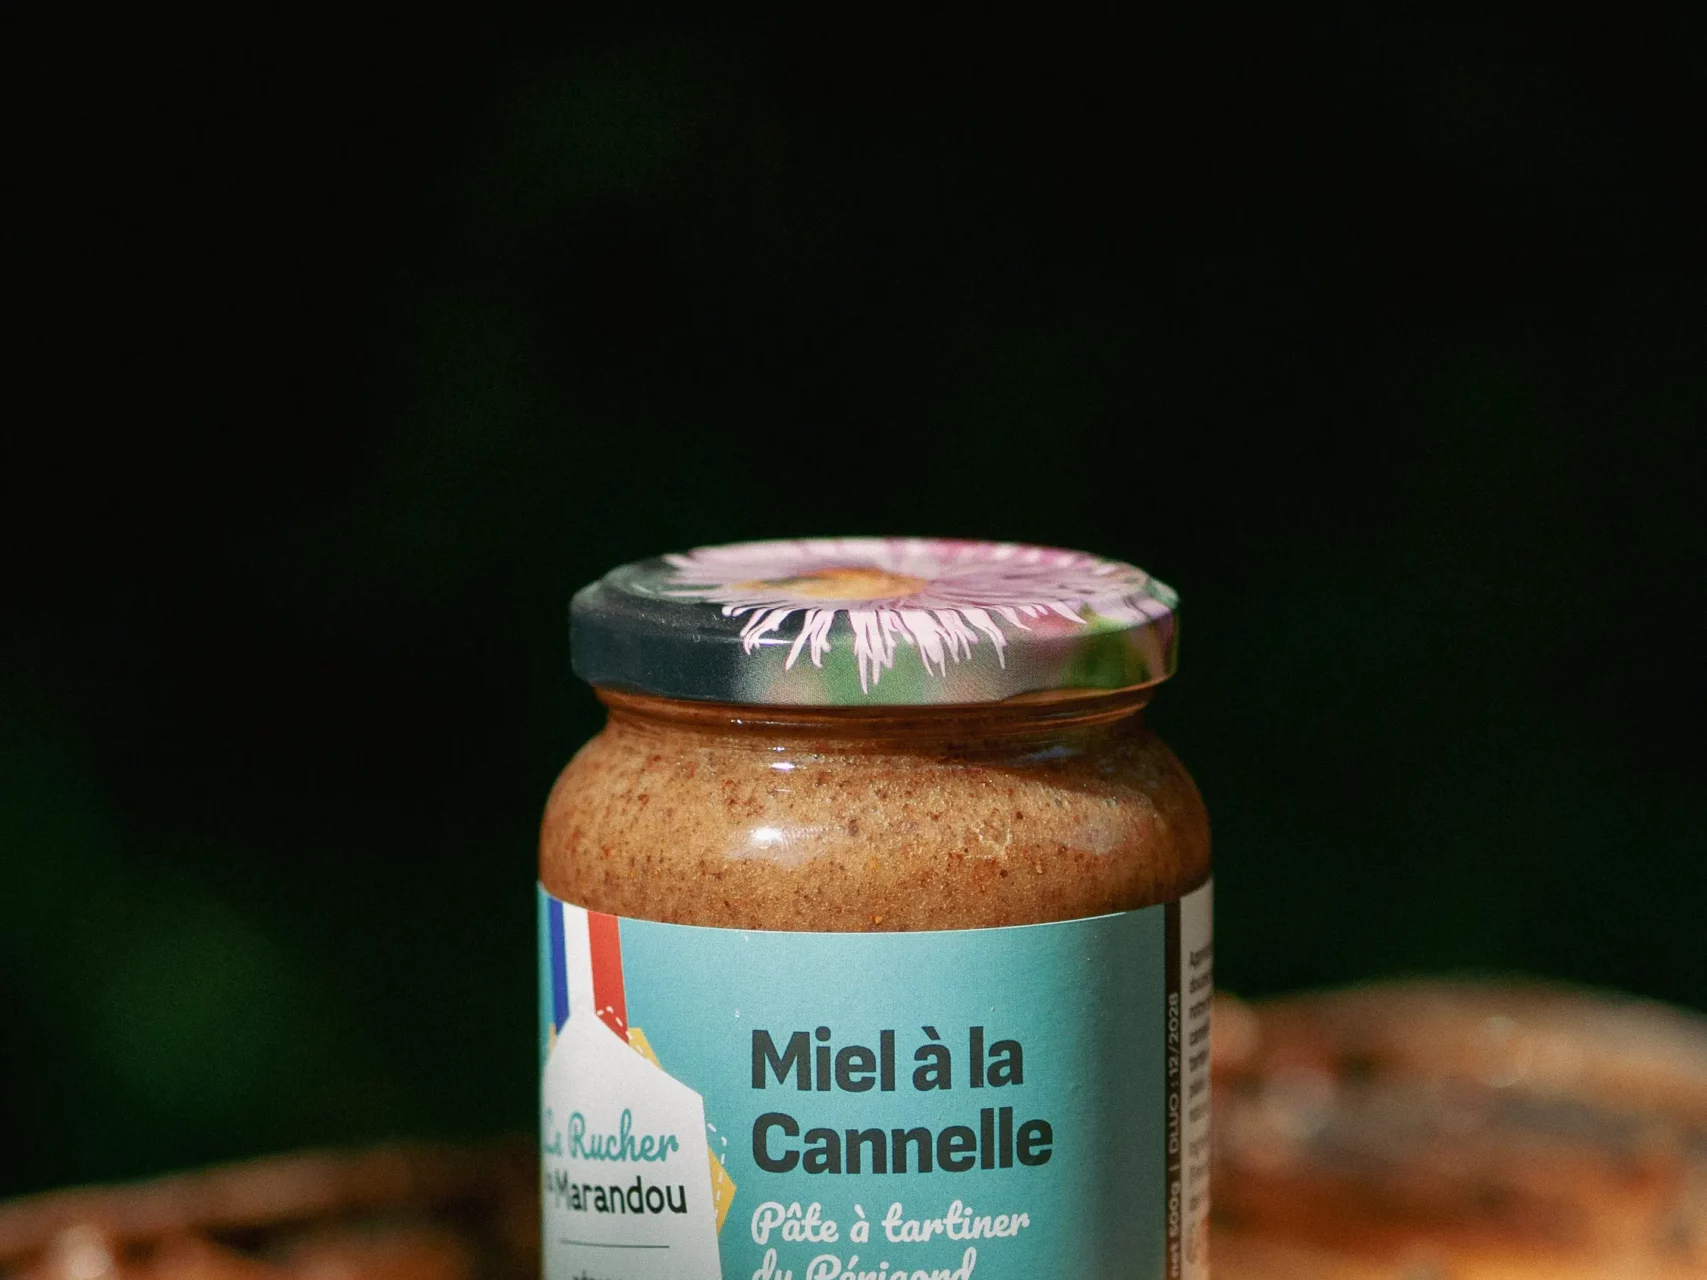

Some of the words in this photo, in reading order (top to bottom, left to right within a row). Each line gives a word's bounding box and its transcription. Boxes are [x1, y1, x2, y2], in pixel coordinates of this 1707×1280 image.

[751, 1026, 896, 1092] Miel
[912, 1026, 952, 1091] à
[969, 1026, 1024, 1088] la
[567, 1108, 680, 1163] Rucher
[752, 1106, 1054, 1174] Cannelle
[555, 1168, 687, 1214] Marandou
[751, 1201, 839, 1245] Pâte
[849, 1204, 870, 1244] à
[882, 1200, 1031, 1244] tartiner
